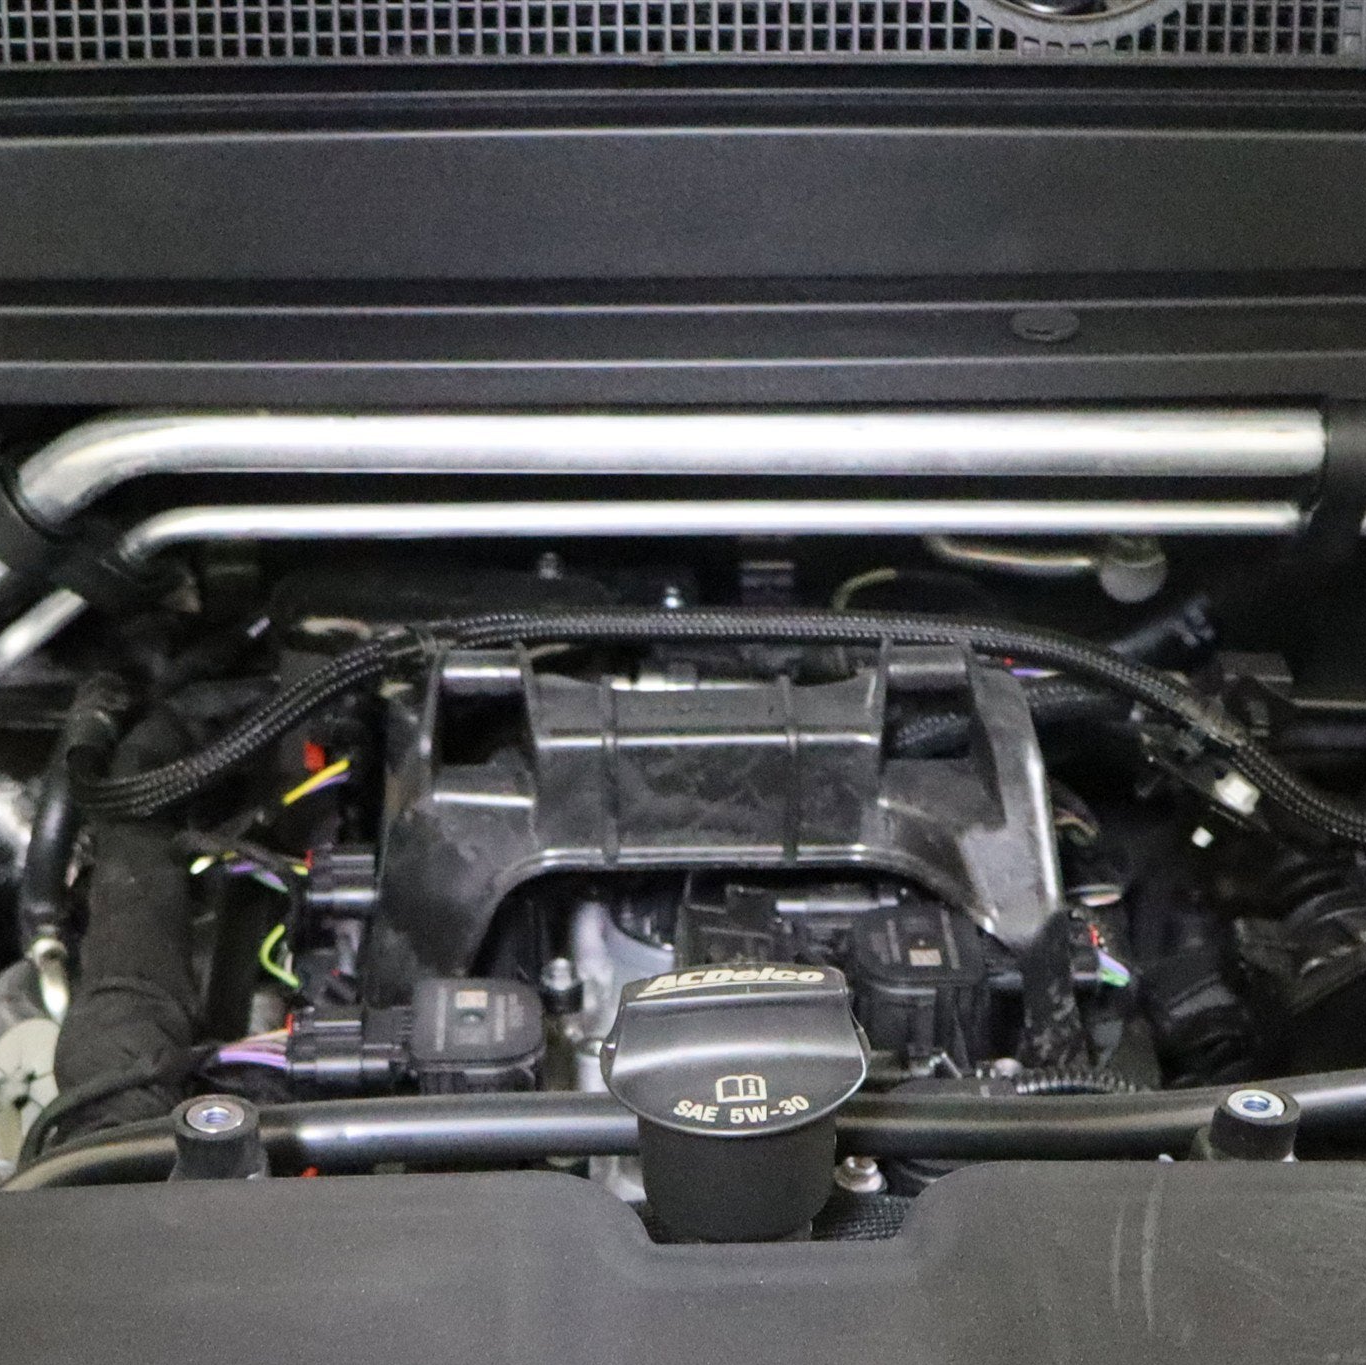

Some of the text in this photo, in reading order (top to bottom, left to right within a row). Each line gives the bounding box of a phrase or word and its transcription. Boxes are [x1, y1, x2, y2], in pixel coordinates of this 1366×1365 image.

[644, 967, 825, 992] ACDelco
[673, 1095, 810, 1124] SAE 5W-30
